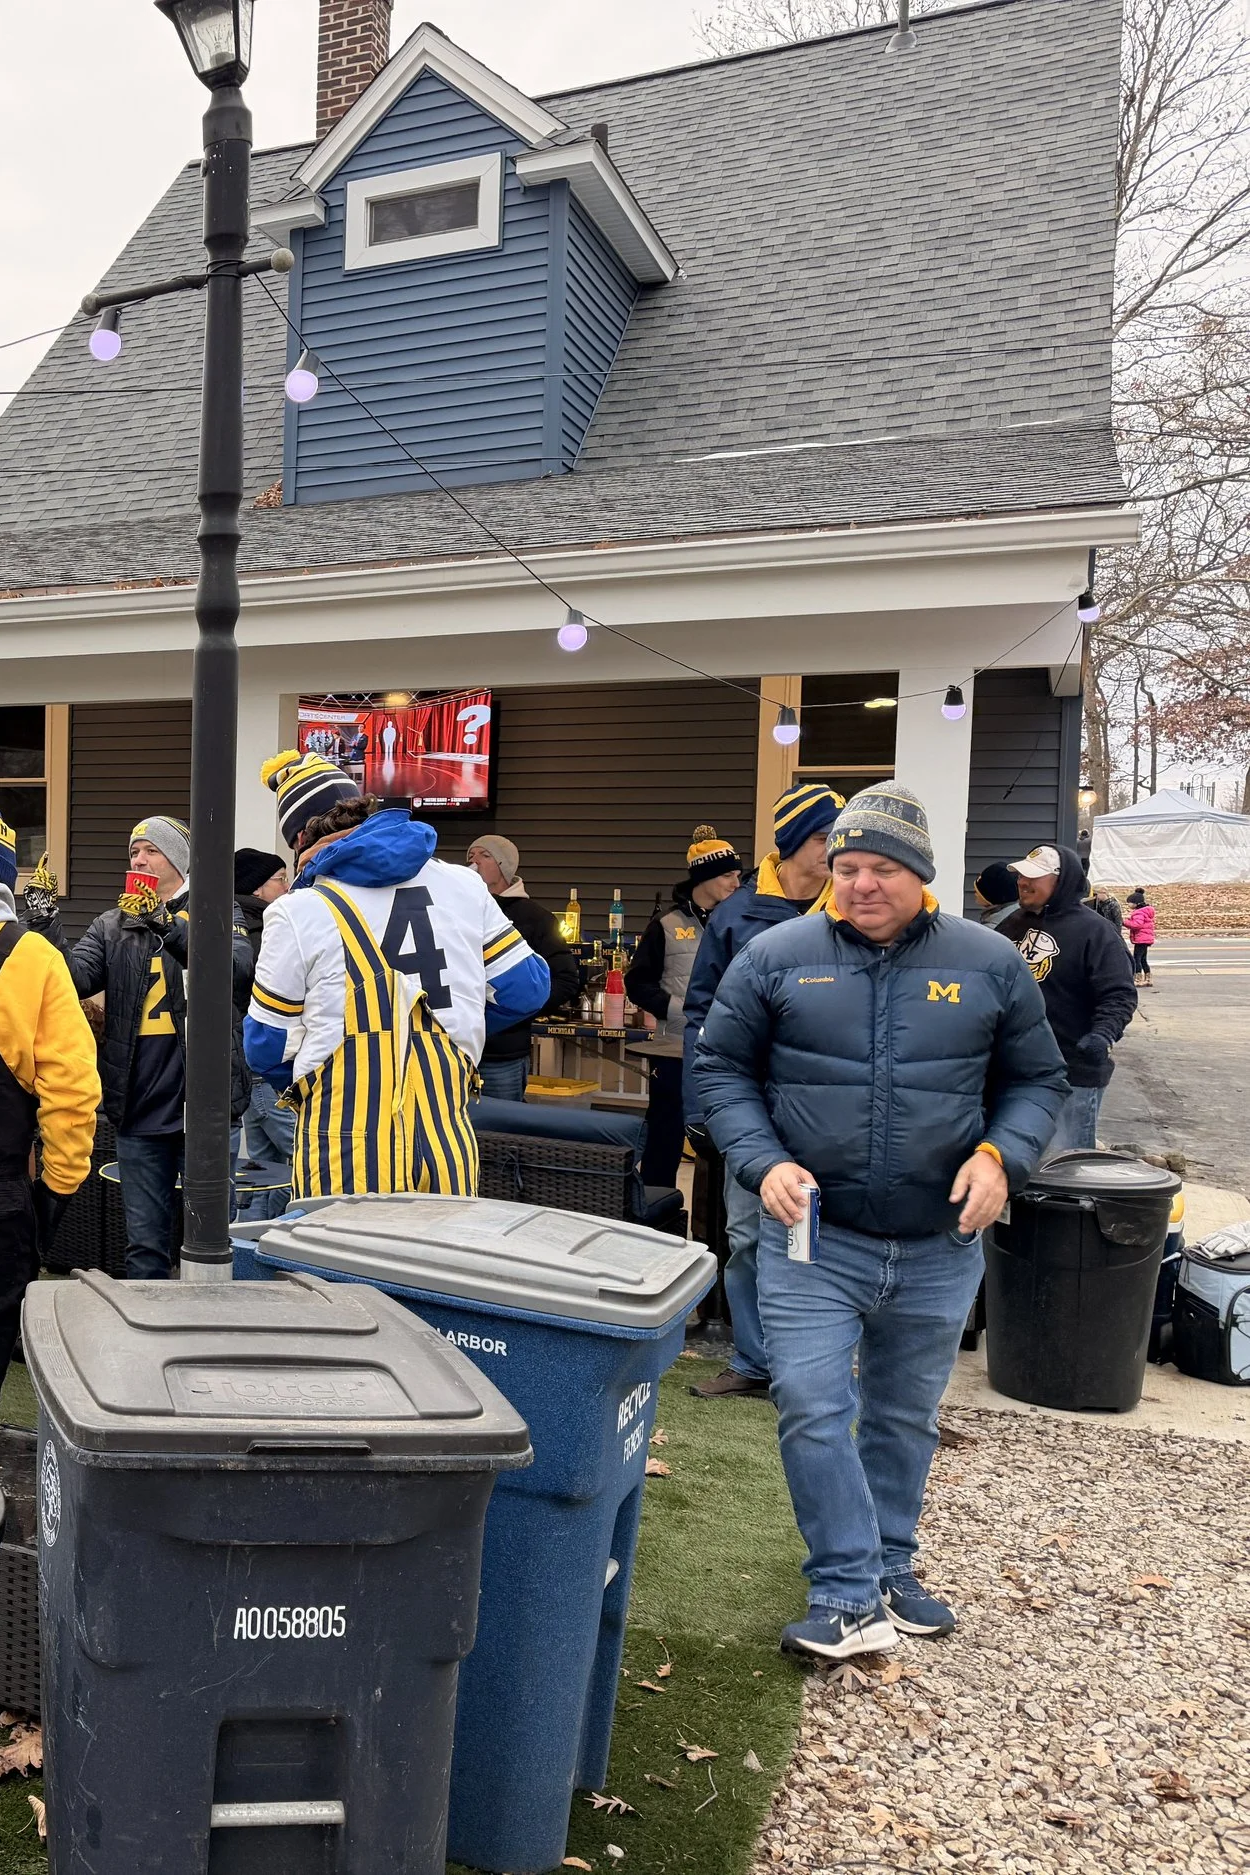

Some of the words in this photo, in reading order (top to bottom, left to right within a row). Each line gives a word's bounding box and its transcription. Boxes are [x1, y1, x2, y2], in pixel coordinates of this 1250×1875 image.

[380, 886, 453, 1010] 4
[675, 927, 695, 940] M
[927, 980, 961, 1003] M
[446, 1330, 507, 1356] ARBOR
[617, 1382, 651, 1433] RECYCLE
[233, 1605, 346, 1640] A0058805
